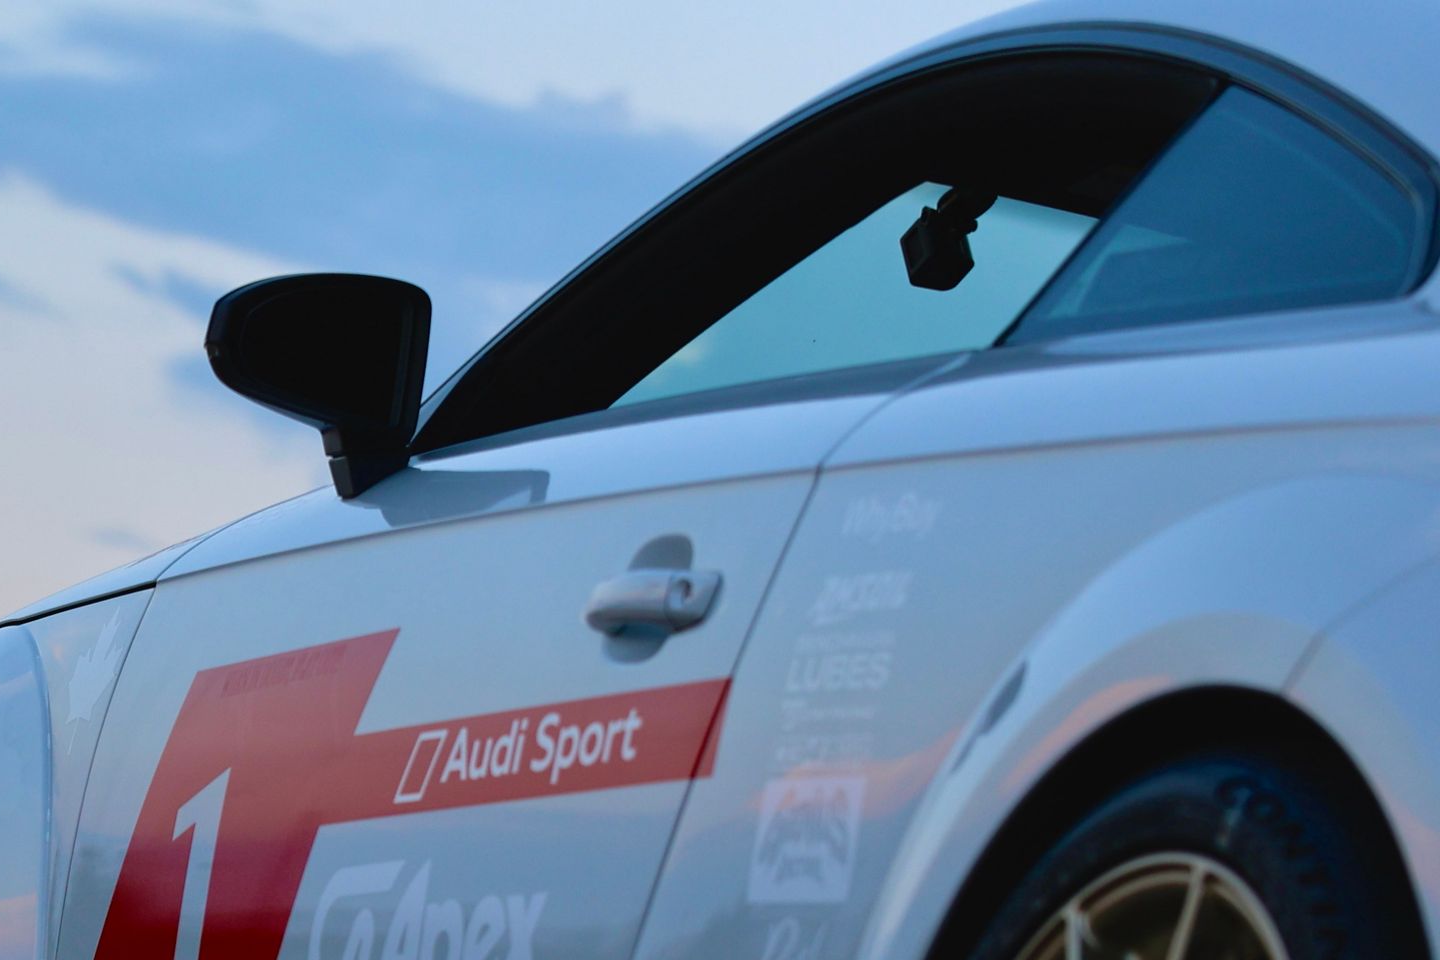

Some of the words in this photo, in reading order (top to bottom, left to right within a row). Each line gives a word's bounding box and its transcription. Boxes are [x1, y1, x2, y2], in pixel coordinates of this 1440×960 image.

[785, 651, 892, 692] LUBES
[439, 726, 529, 784] Audi
[530, 707, 643, 786] Sport
